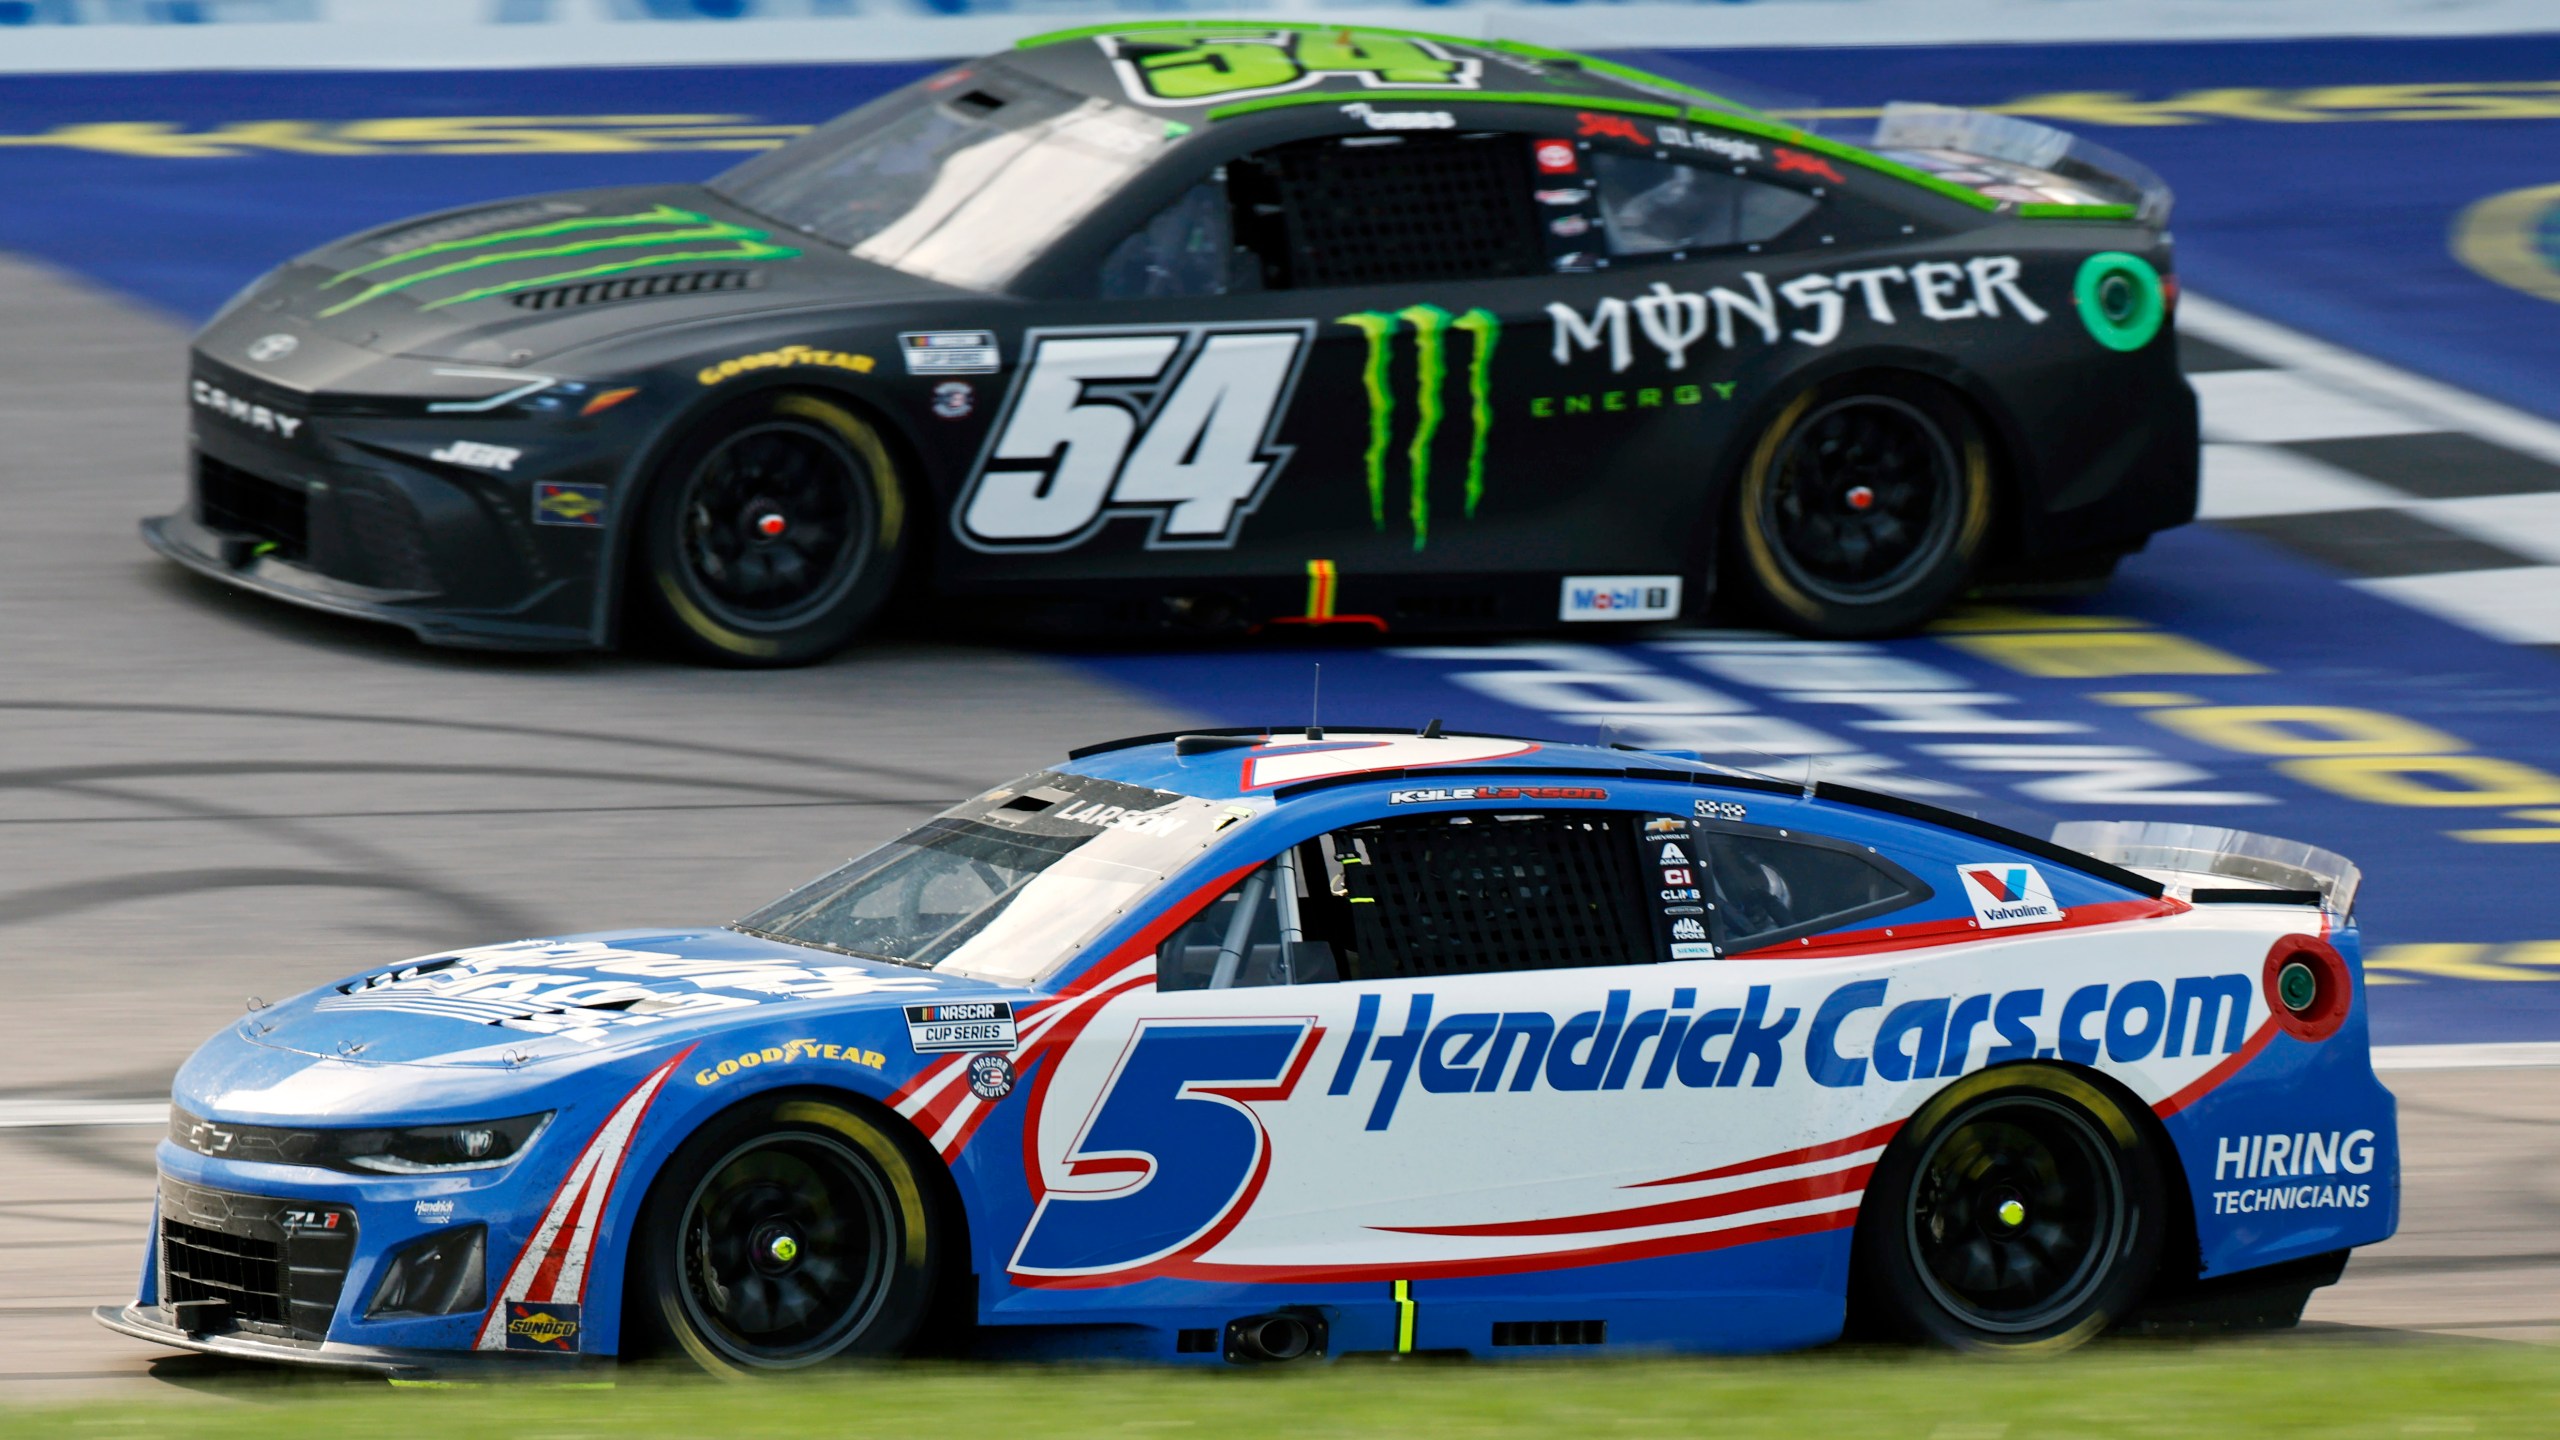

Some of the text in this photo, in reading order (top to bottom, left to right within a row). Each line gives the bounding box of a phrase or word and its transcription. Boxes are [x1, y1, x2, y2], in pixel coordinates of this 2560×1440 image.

[1095, 28, 1484, 108] 54
[1544, 256, 2049, 373] MONSTER
[696, 345, 877, 386] GOODYEAR
[192, 379, 302, 439] CAMRY
[1530, 380, 1739, 418] ENERGY
[950, 318, 1318, 553] 54
[1573, 587, 1640, 611] Mobil
[1053, 800, 1189, 838] LARSON
[1645, 834, 1690, 842] CHEVROLET
[1660, 888, 1701, 901] CLIMB
[1983, 905, 2048, 921] Valvoline
[1672, 917, 1705, 934] MAC
[1673, 932, 1706, 940] TOOLS
[940, 1004, 996, 1021] NASCAR
[926, 1024, 1001, 1041] CUP SERIES
[695, 1038, 886, 1087] GOODYEAR
[972, 1056, 1009, 1073] NASCAR
[973, 1080, 1011, 1098] SALUTES
[1006, 1014, 1328, 1282] 5
[2214, 1129, 2376, 1181] HIRING
[414, 1200, 454, 1216] Hendrick
[2212, 1183, 2371, 1215] TECHNICIANS
[282, 1210, 340, 1229] ZL1
[511, 1321, 575, 1336] SUNOCO
